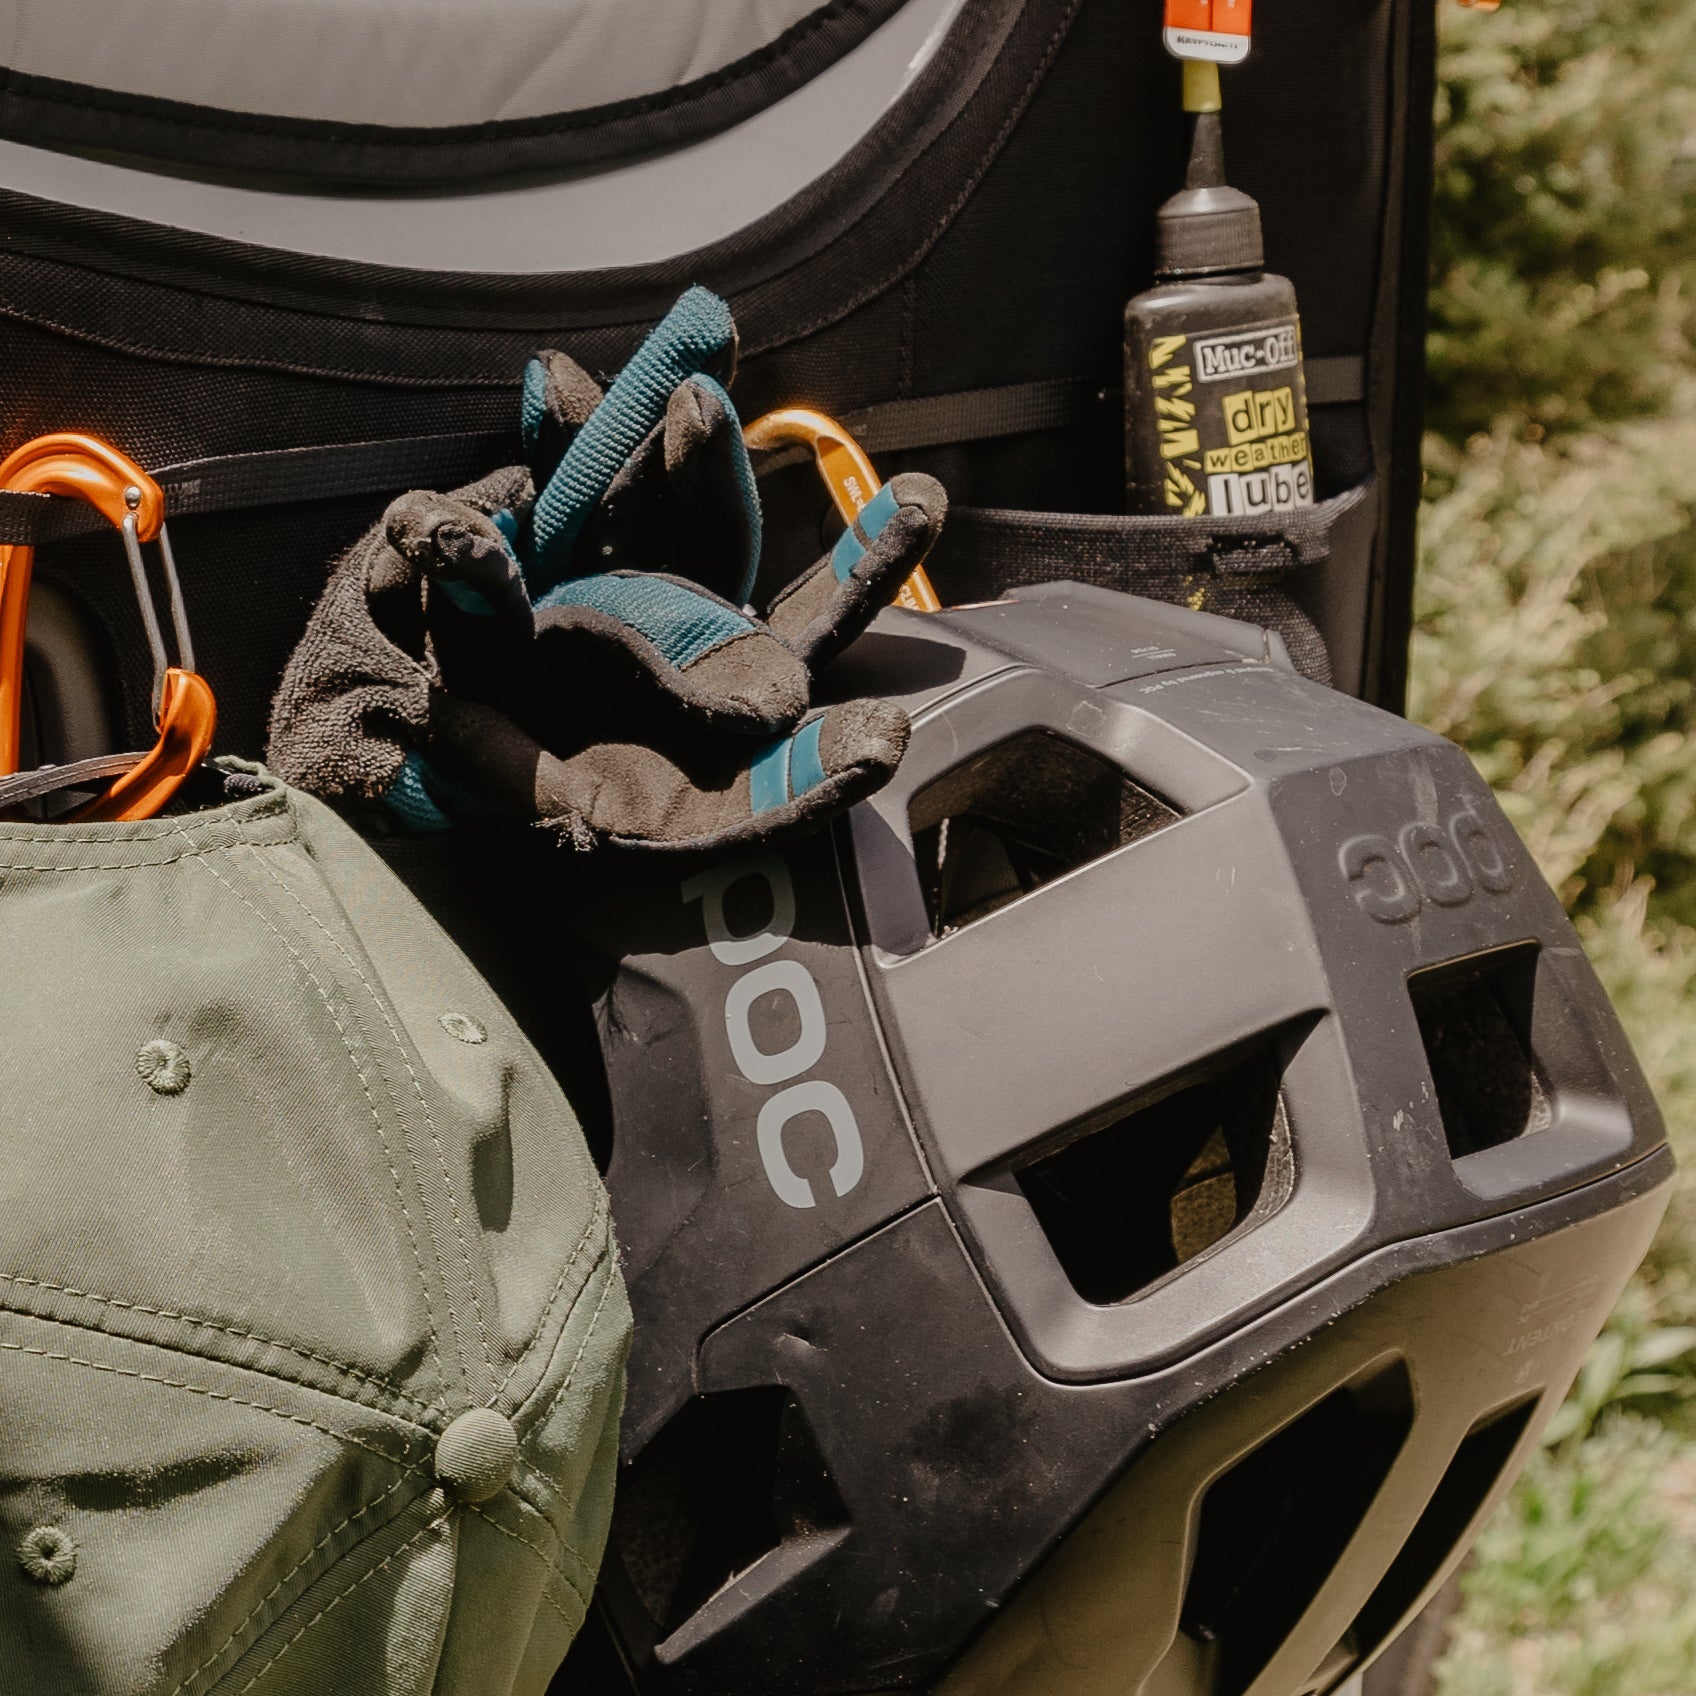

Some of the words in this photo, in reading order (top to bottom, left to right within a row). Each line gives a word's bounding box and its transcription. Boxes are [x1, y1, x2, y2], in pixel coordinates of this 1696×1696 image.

[1201, 329, 1296, 375] Muc-Off
[1231, 391, 1293, 433] dry
[1209, 437, 1307, 468] weather
[1223, 469, 1311, 515] lube
[680, 849, 865, 1209] POC
